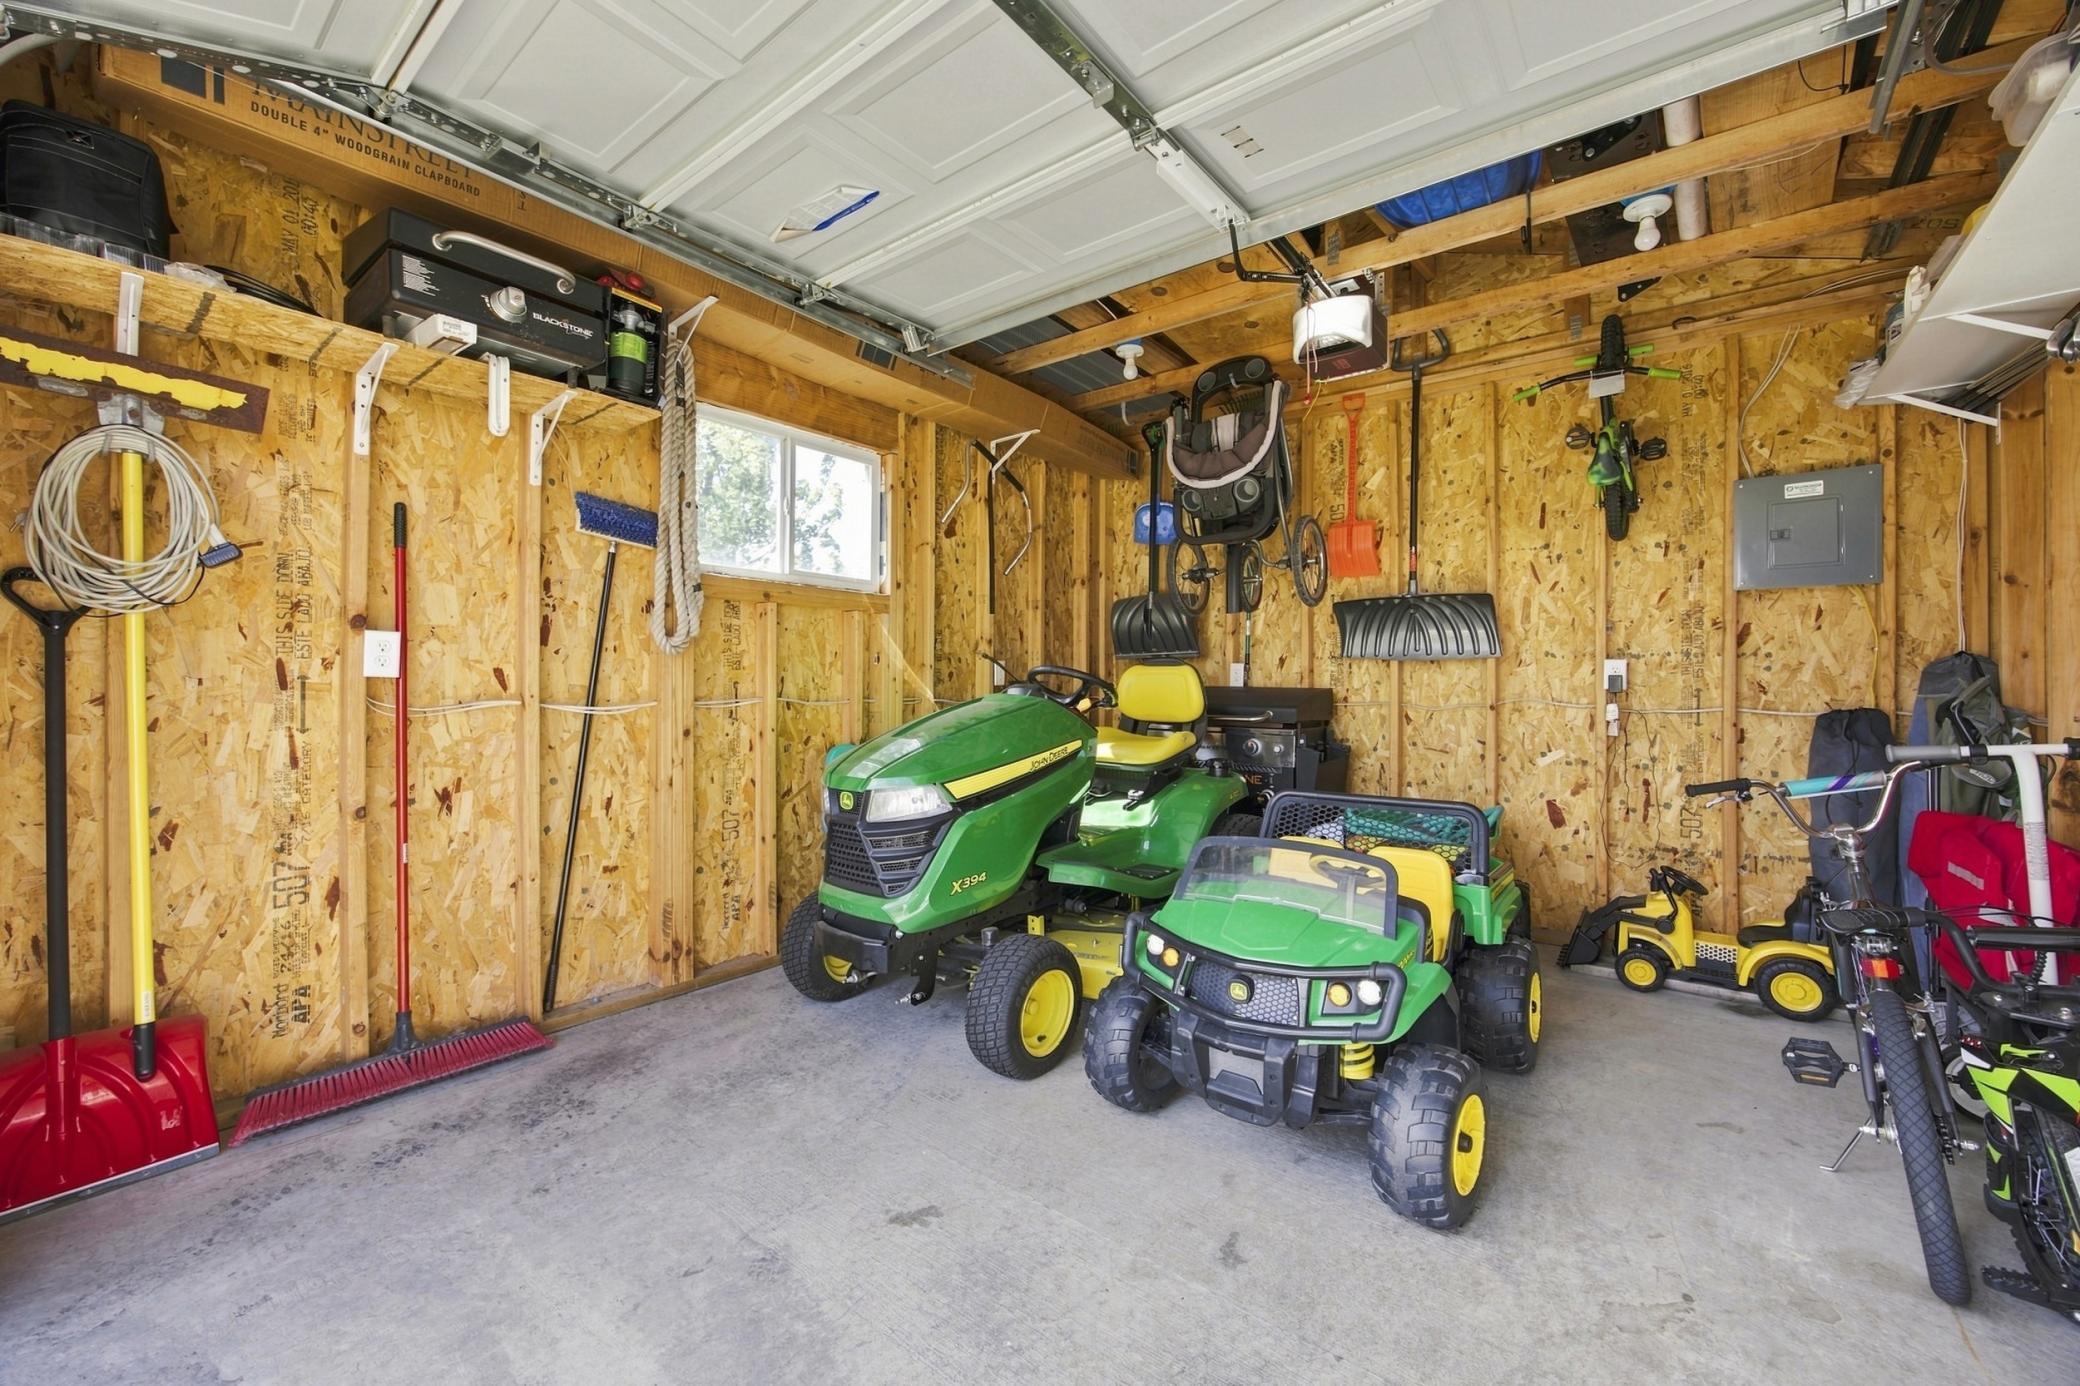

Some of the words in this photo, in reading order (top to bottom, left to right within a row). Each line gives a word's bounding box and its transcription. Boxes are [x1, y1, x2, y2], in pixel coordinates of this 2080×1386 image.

[251, 101, 308, 131] DOUBLE
[313, 125, 329, 137] 4"
[335, 134, 410, 171] WOODGRAIN
[414, 164, 481, 197] CLAPBOARD
[532, 312, 594, 338] BLACKSTONE
[275, 552, 293, 584] DOWN
[294, 593, 312, 624] LADO
[275, 621, 293, 656] THIS
[294, 629, 312, 660] ESTE
[300, 740, 312, 805] CATEGORY
[1030, 757, 1049, 772] JOHN
[1049, 746, 1068, 762] DEERE
[721, 809, 740, 842] 507
[1680, 808, 1703, 840] 507
[272, 861, 310, 910] 507
[950, 872, 987, 896] X394
[291, 984, 311, 1024] APA
